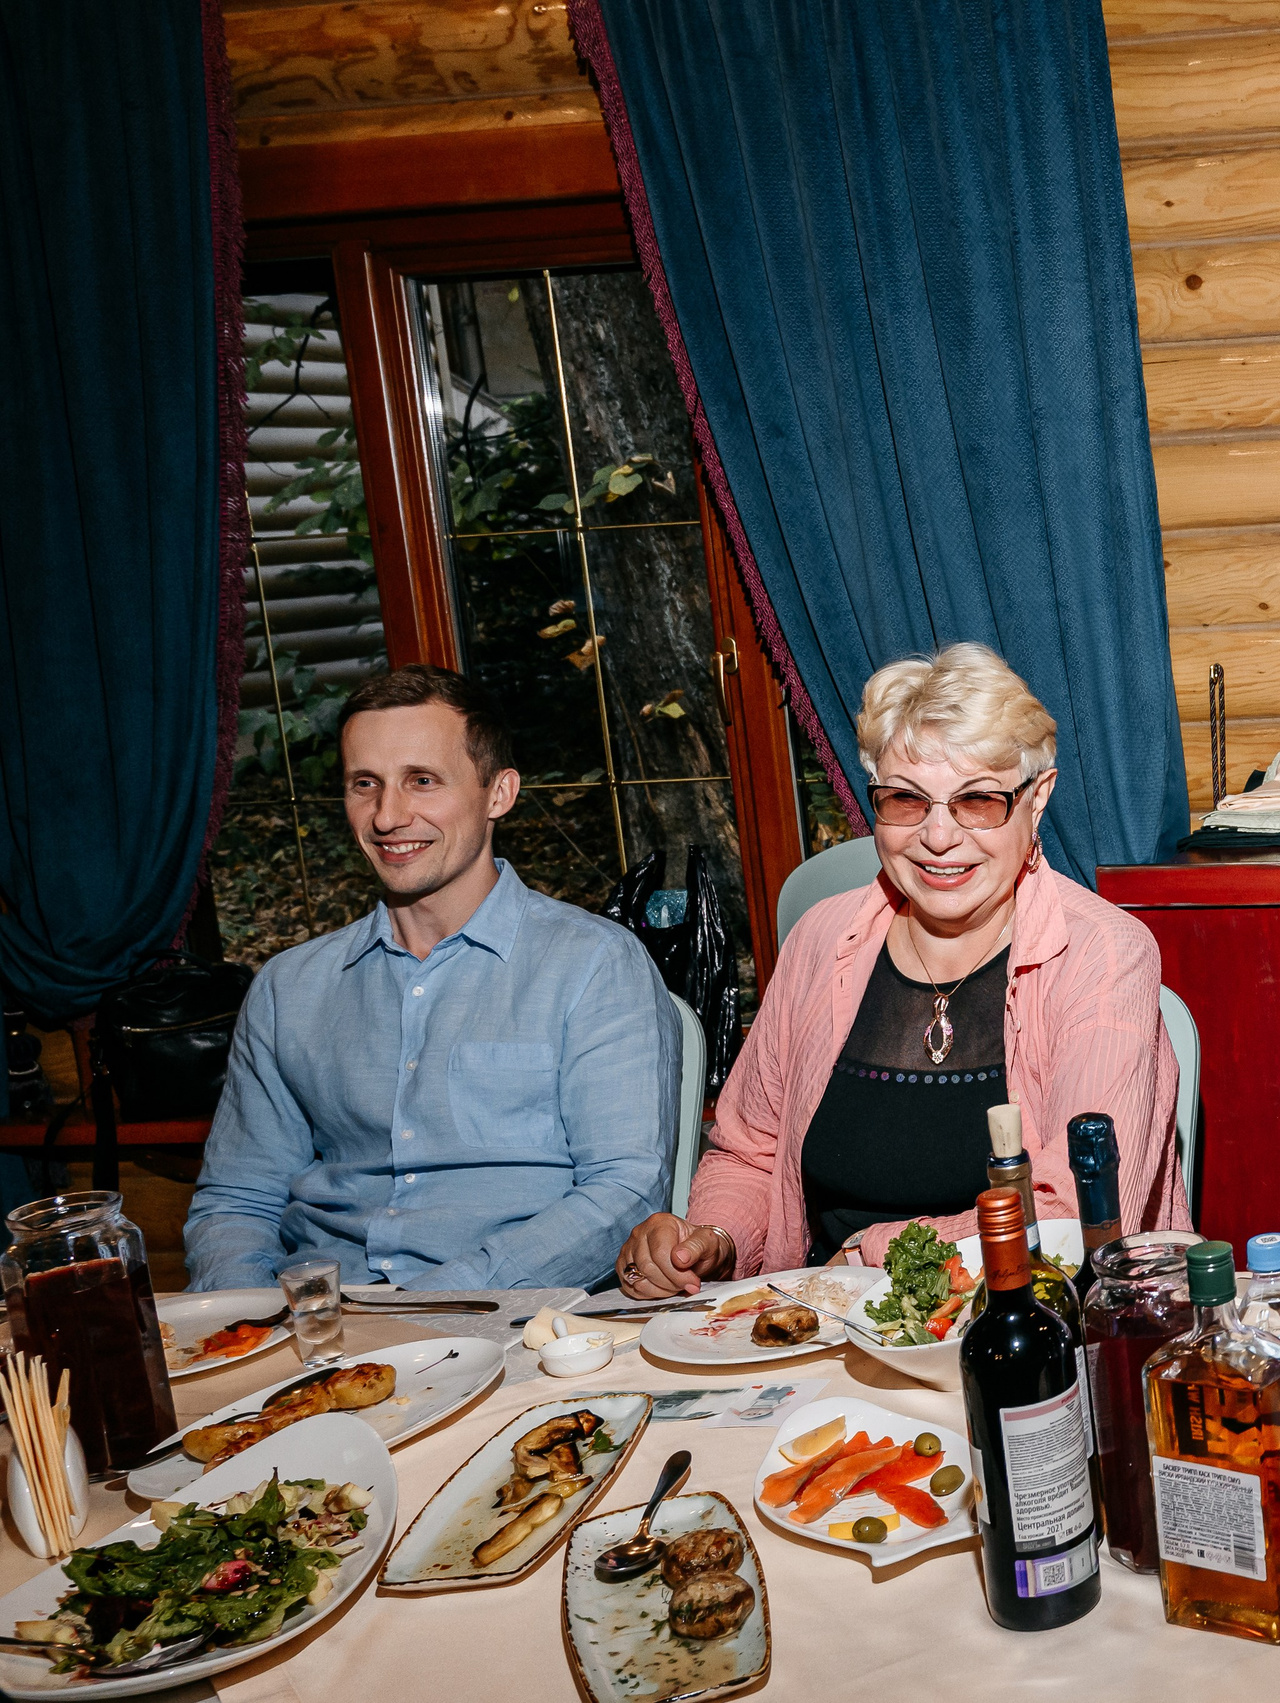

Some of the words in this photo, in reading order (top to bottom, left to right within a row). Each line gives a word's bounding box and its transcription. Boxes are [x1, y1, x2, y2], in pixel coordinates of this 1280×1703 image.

[1014, 1485, 1056, 1500] Чрезмерное
[1015, 1496, 1047, 1507] алкоголя
[1047, 1488, 1069, 1502] вредит
[1016, 1503, 1052, 1515] здоровью.
[1017, 1514, 1066, 1532] Центральная
[1046, 1523, 1064, 1536] 2021
